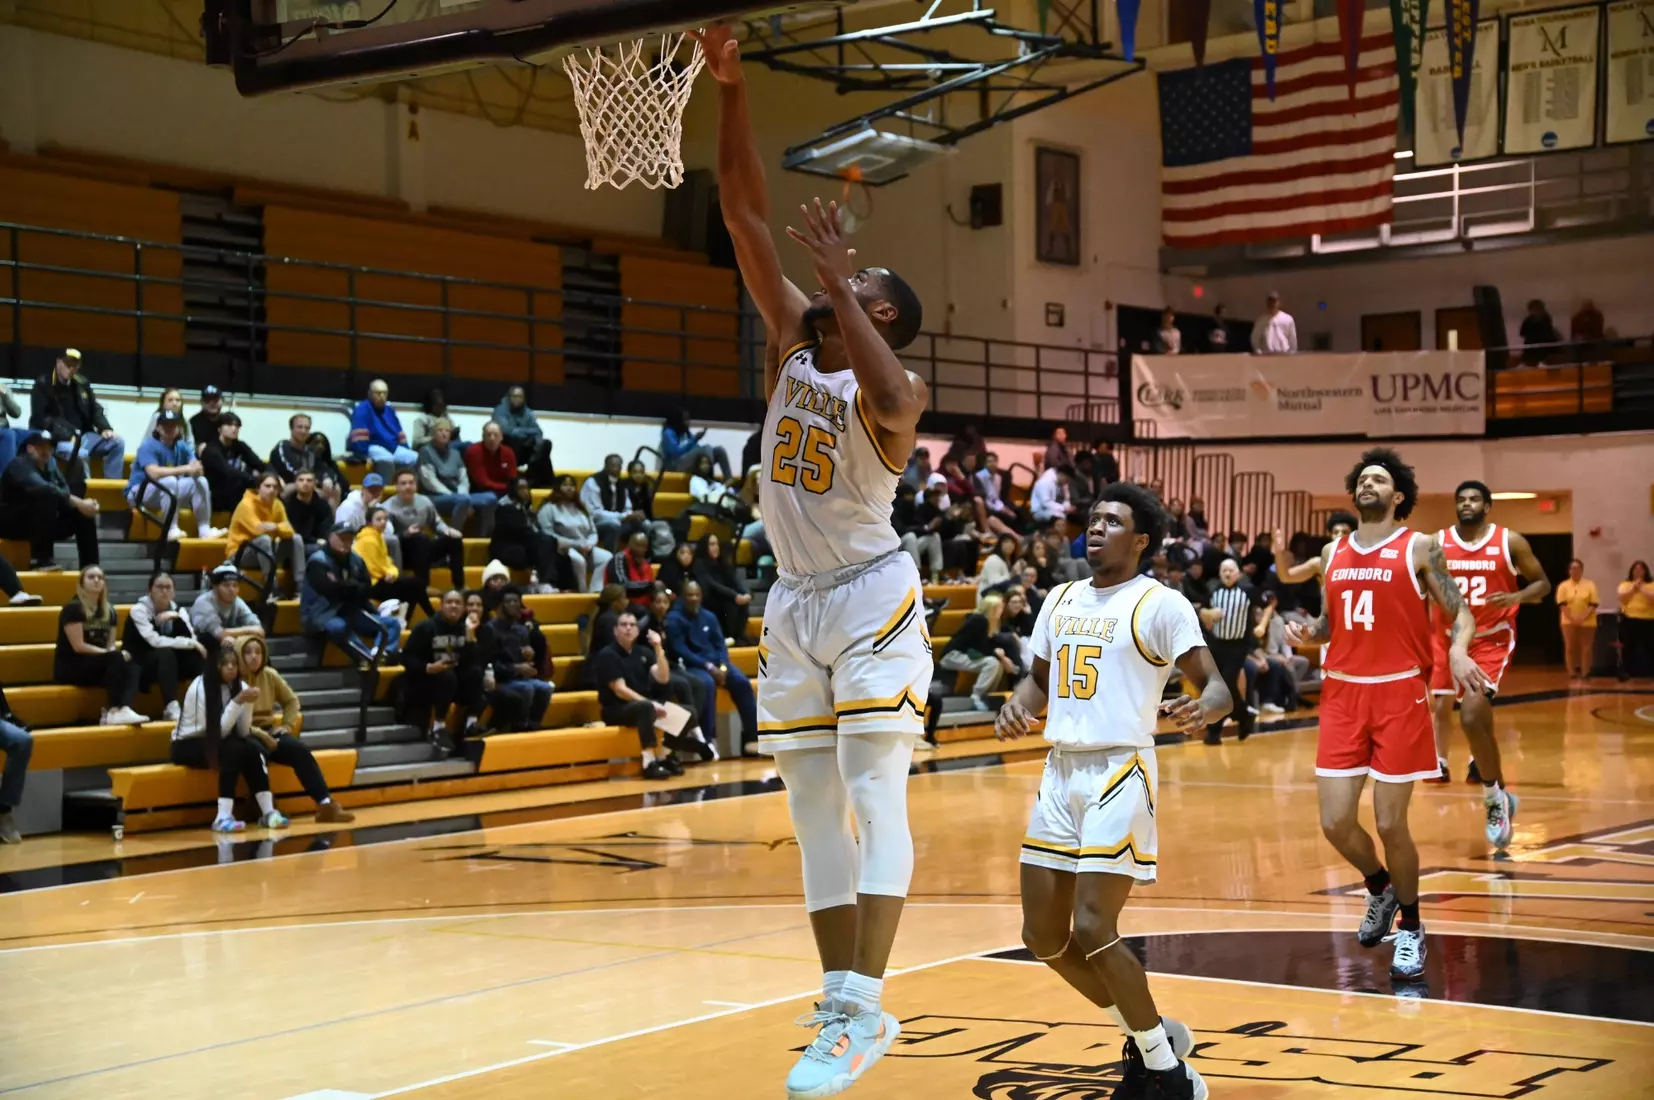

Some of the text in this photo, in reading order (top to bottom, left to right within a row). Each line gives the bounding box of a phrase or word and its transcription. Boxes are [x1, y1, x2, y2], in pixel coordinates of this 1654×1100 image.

[1276, 386, 1363, 398] Northwestern
[1370, 372, 1480, 403] UPMC
[784, 376, 848, 433] VILLE
[1277, 398, 1322, 411] Mutual
[771, 415, 837, 495] 25
[1331, 567, 1393, 582] EDINBORO
[1455, 576, 1487, 606] 22
[1341, 590, 1375, 631] 14
[1054, 615, 1118, 644] VILLE
[1057, 644, 1102, 700] 15
